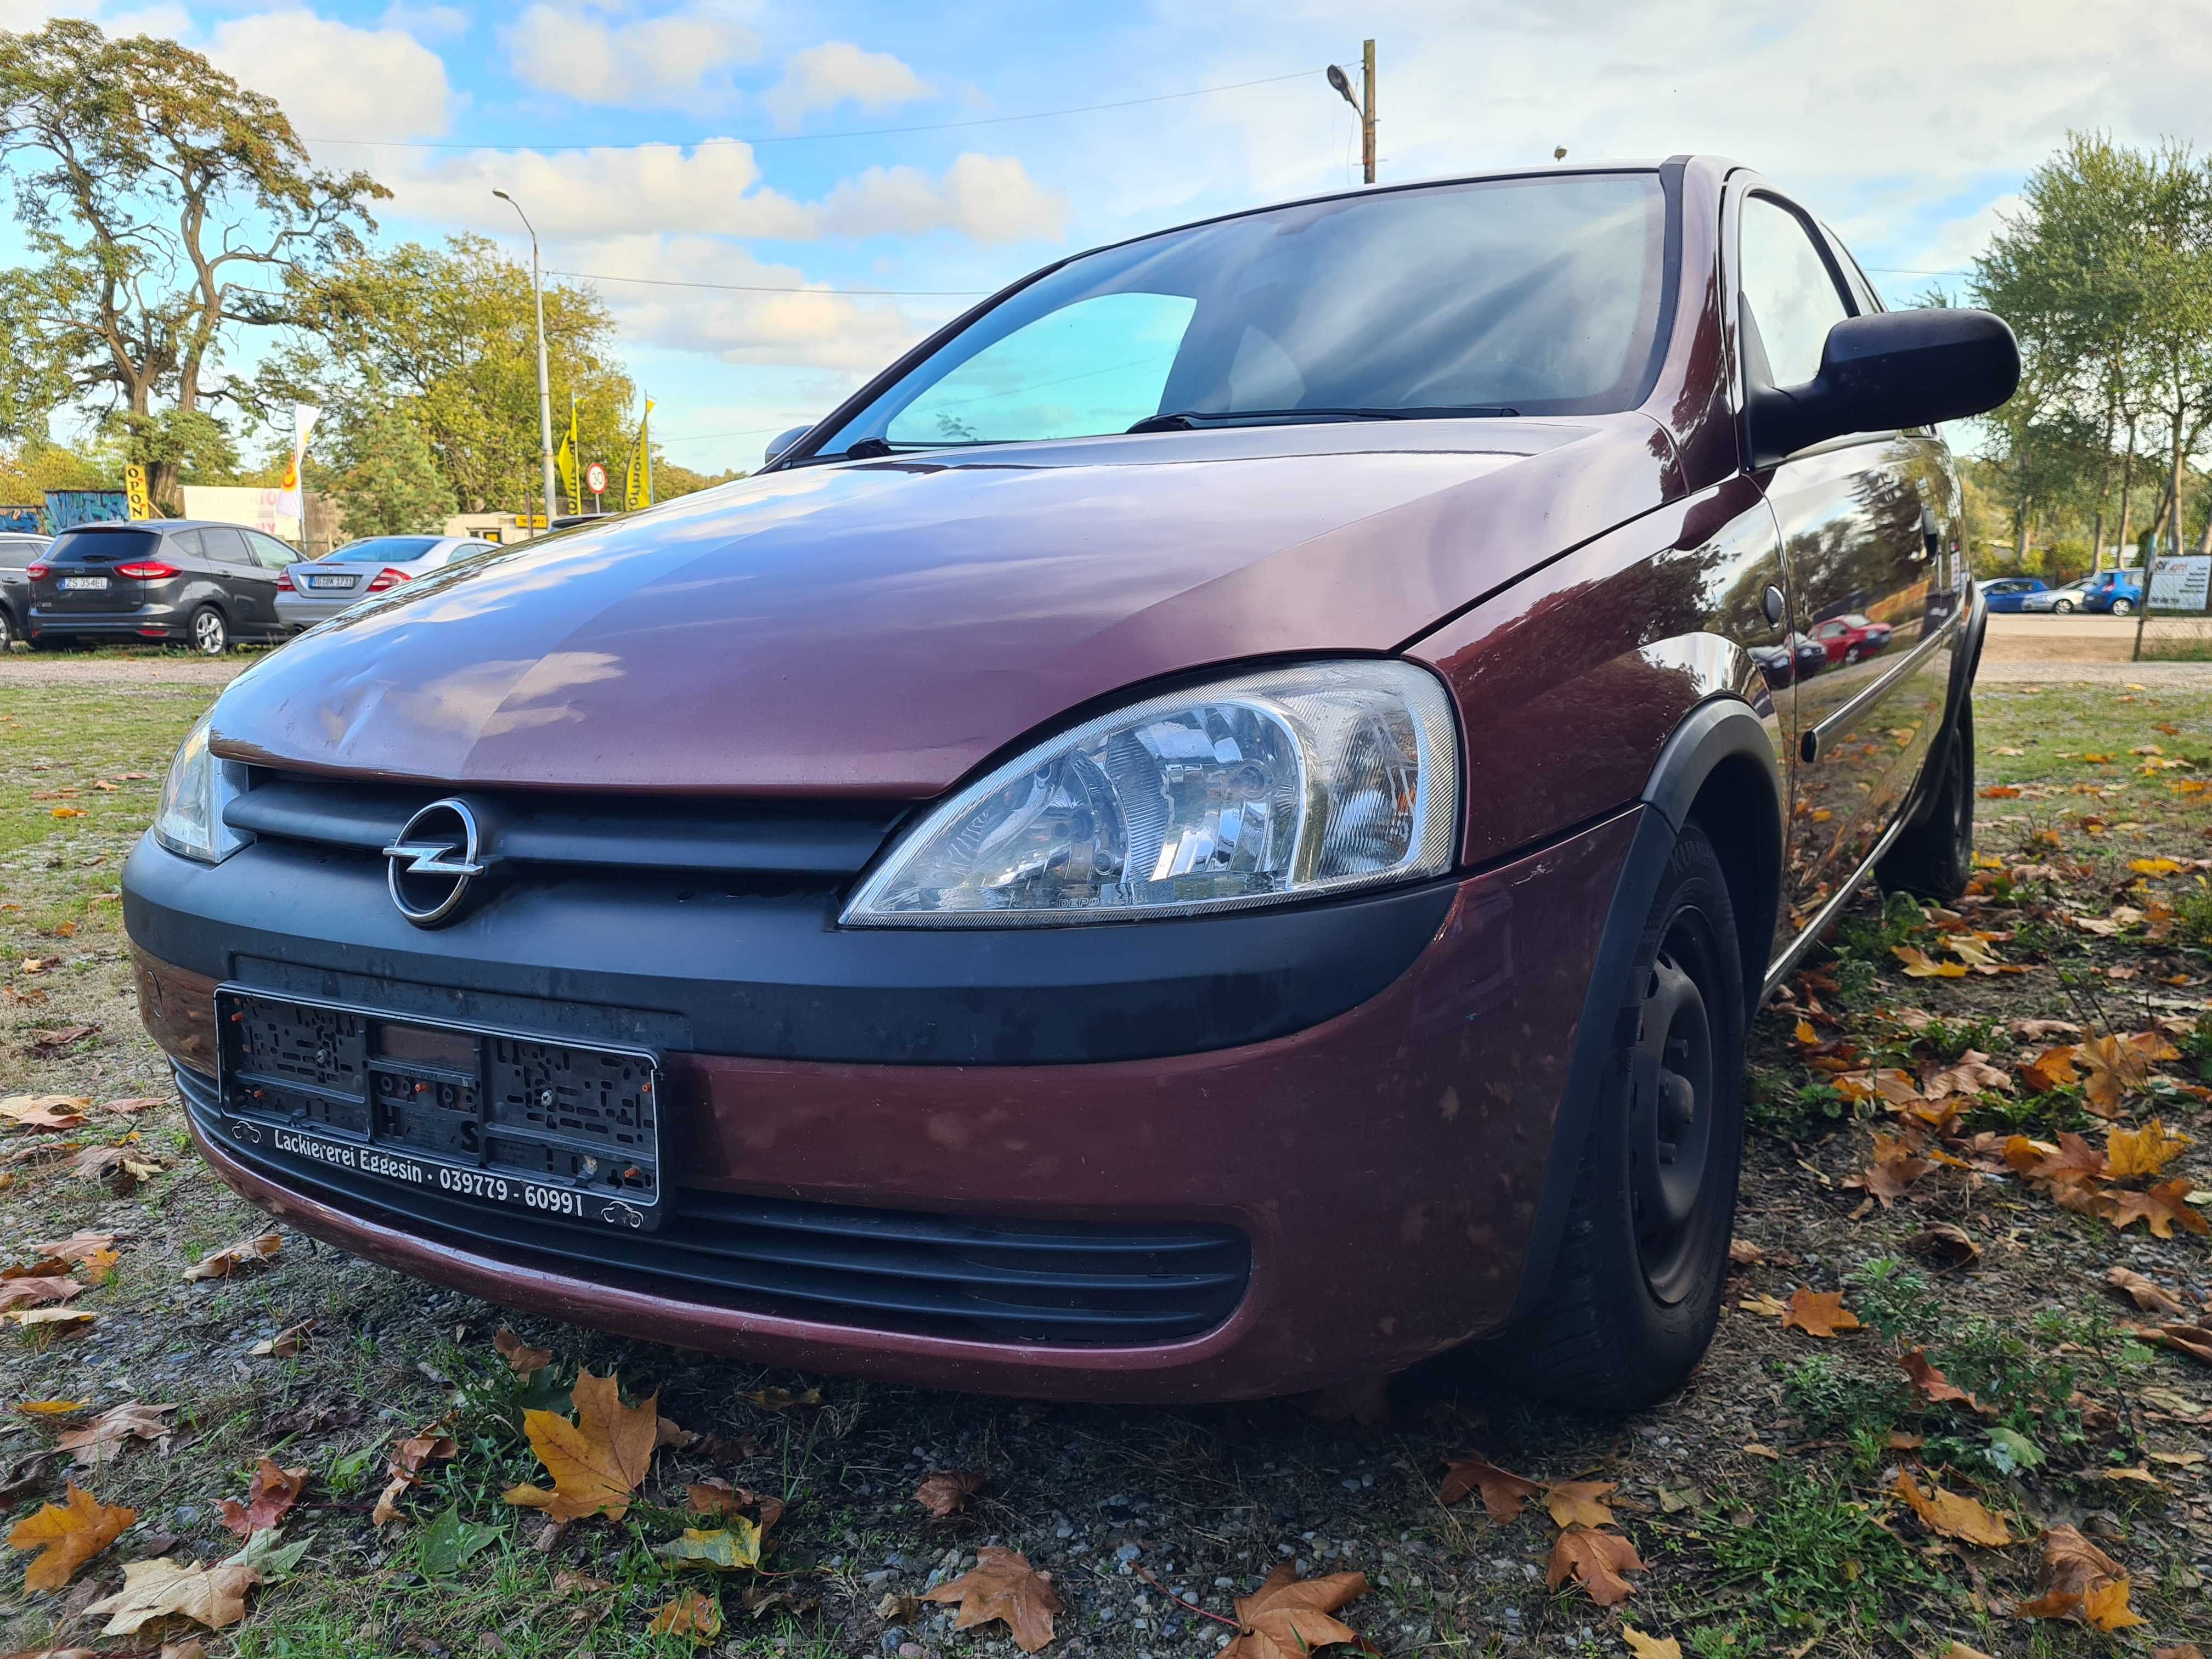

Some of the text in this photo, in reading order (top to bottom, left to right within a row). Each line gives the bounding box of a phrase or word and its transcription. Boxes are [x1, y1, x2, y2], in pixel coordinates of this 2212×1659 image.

[592, 472, 603, 486] 30
[1058, 896, 1099, 909] DEPO
[275, 1128, 356, 1167] Lackiererei
[360, 1149, 422, 1183] Eggesin
[439, 1168, 508, 1201] 039779
[524, 1185, 583, 1216] 60991
